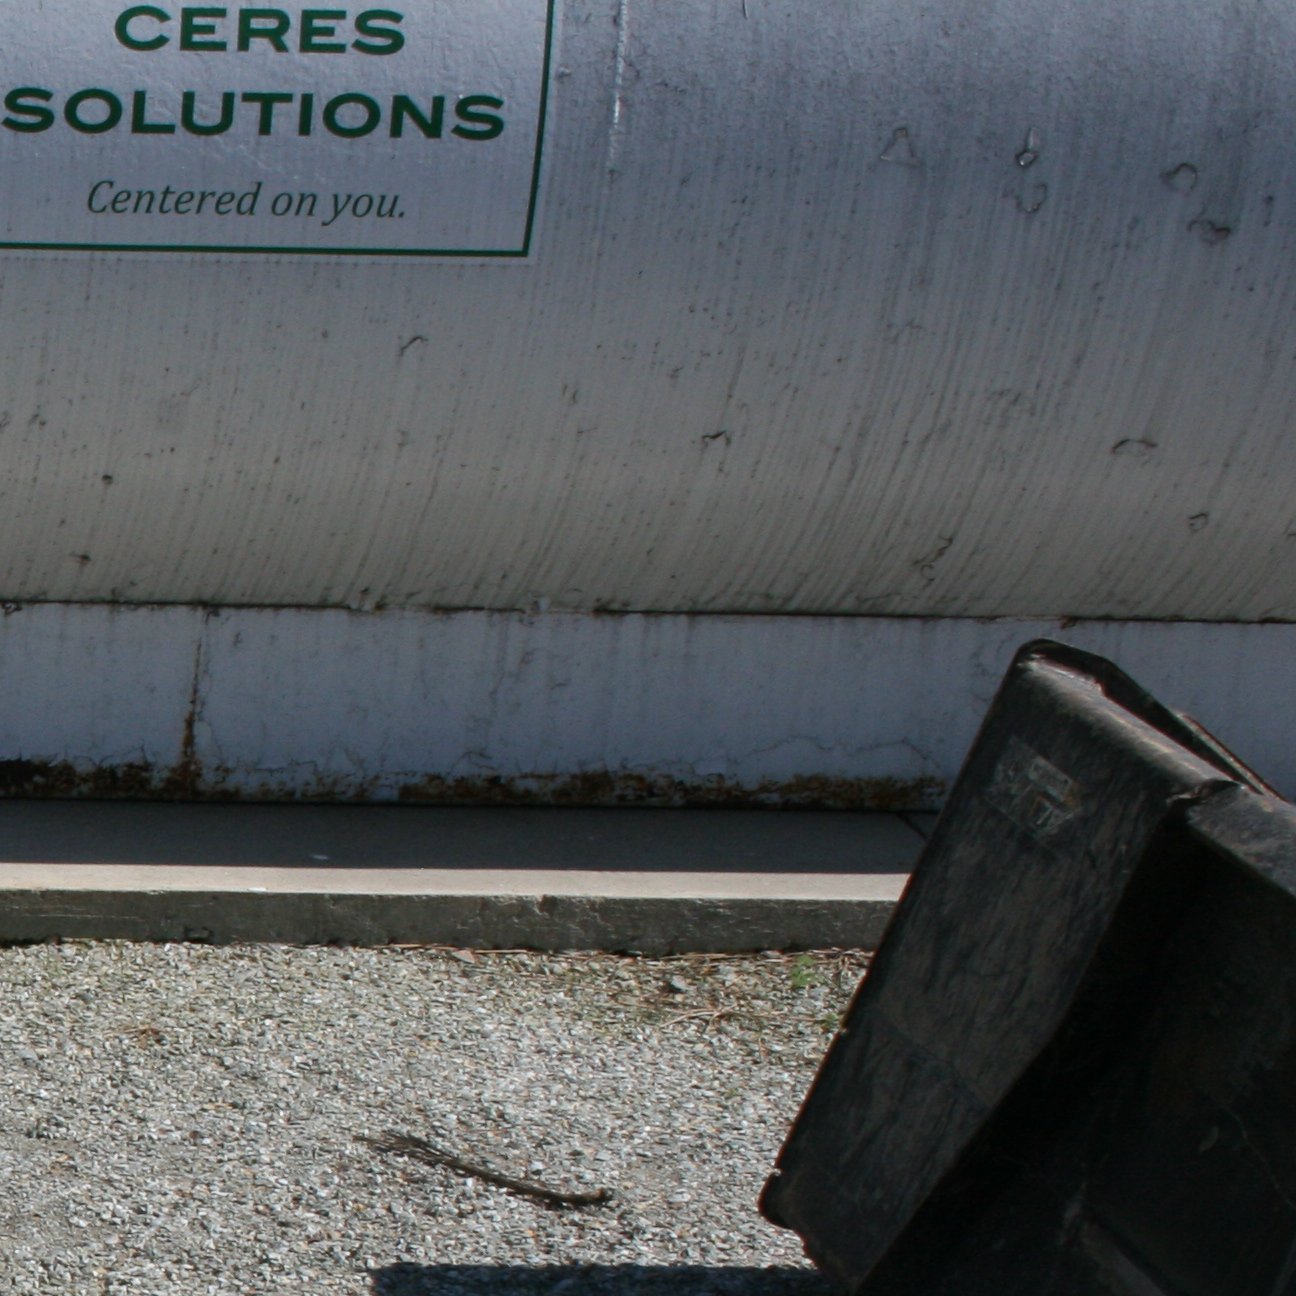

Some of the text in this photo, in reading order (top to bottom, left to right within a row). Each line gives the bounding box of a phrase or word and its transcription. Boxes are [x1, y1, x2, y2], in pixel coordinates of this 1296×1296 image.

[114, 6, 406, 55] CERES
[2, 87, 505, 141] SOLUTIONS
[87, 180, 406, 226] Centered on you.
